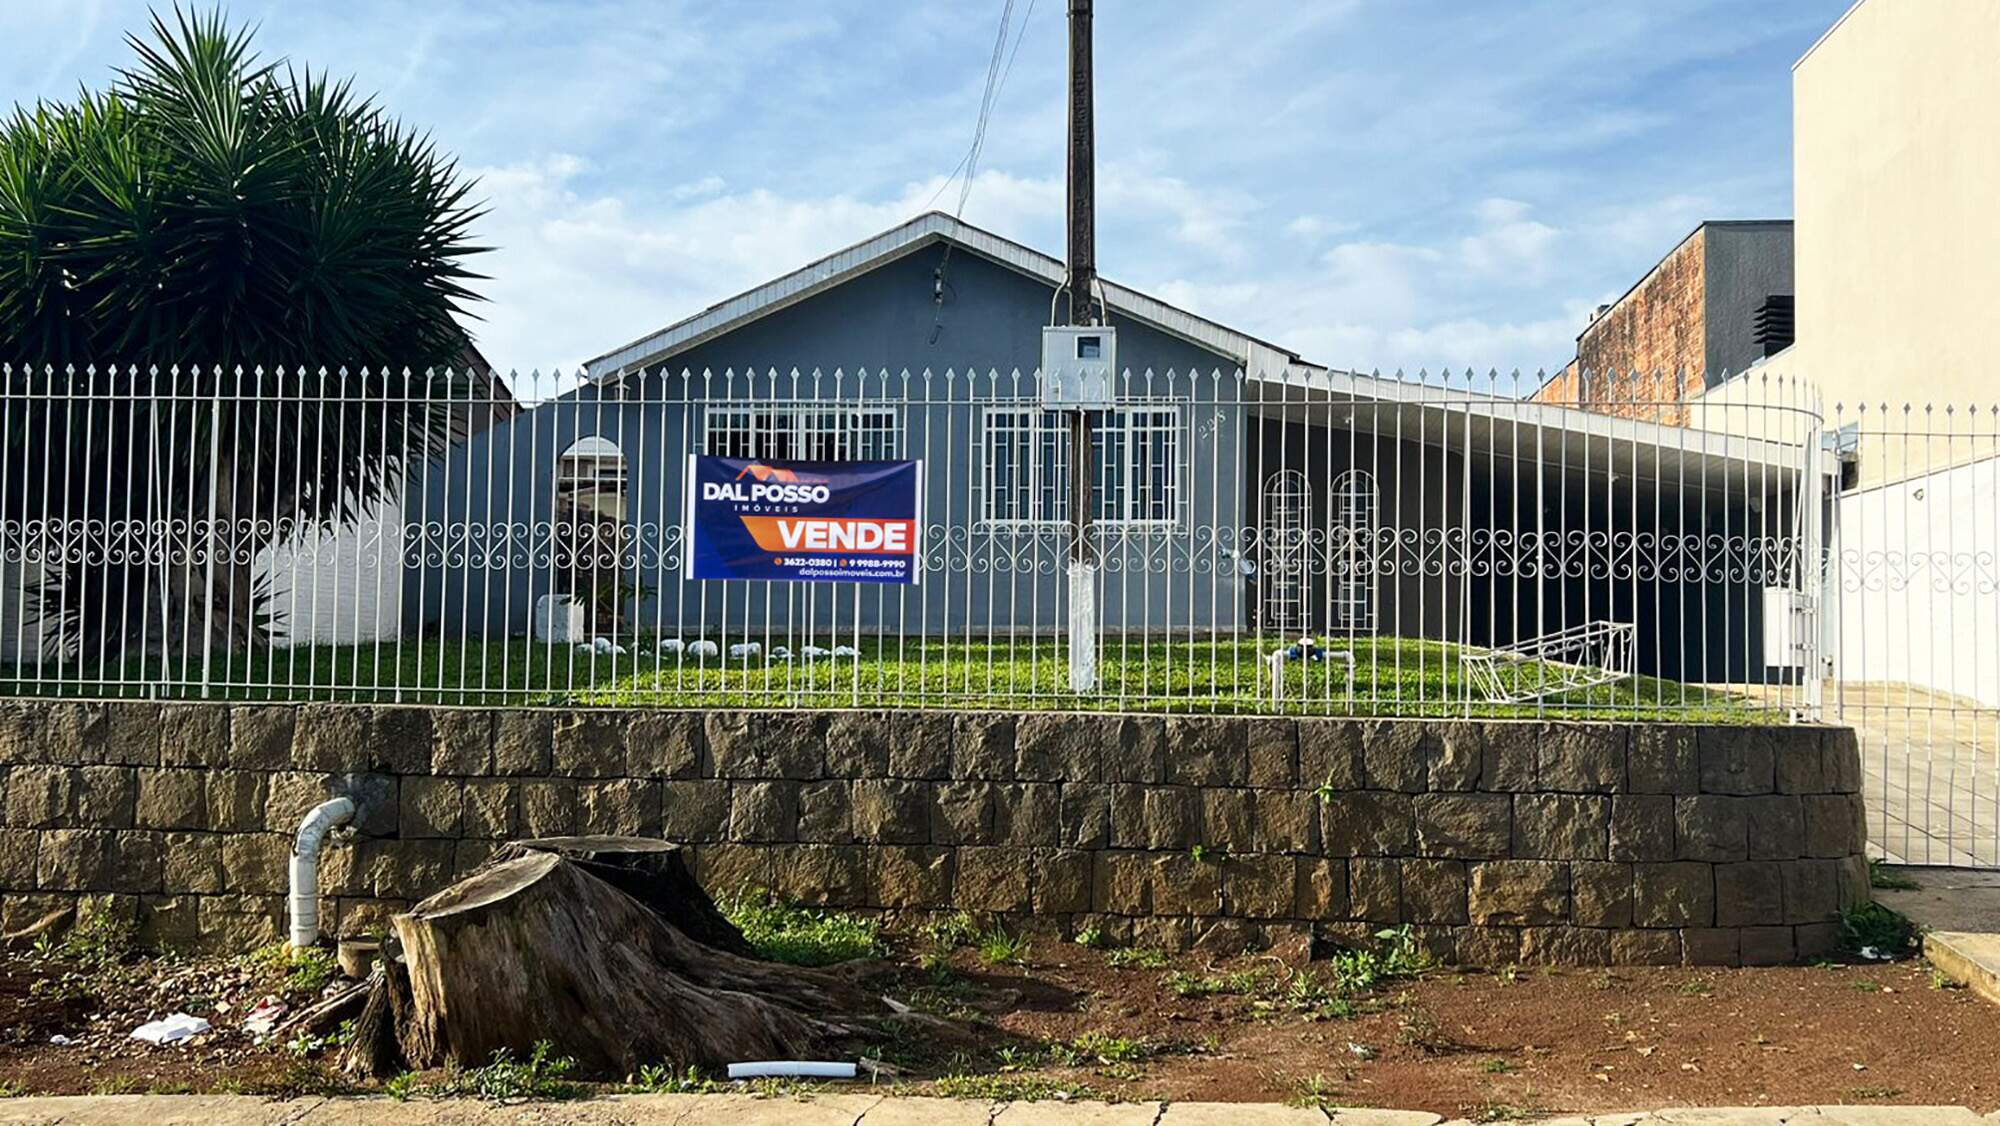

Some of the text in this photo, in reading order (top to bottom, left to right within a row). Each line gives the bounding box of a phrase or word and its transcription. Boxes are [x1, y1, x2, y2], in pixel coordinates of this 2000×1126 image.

[703, 482, 830, 504] DAL POSSO
[734, 503, 799, 513] IMÓVEIS
[777, 520, 907, 551] VENDE
[799, 567, 905, 577] dalpossoimoveis.com.br
